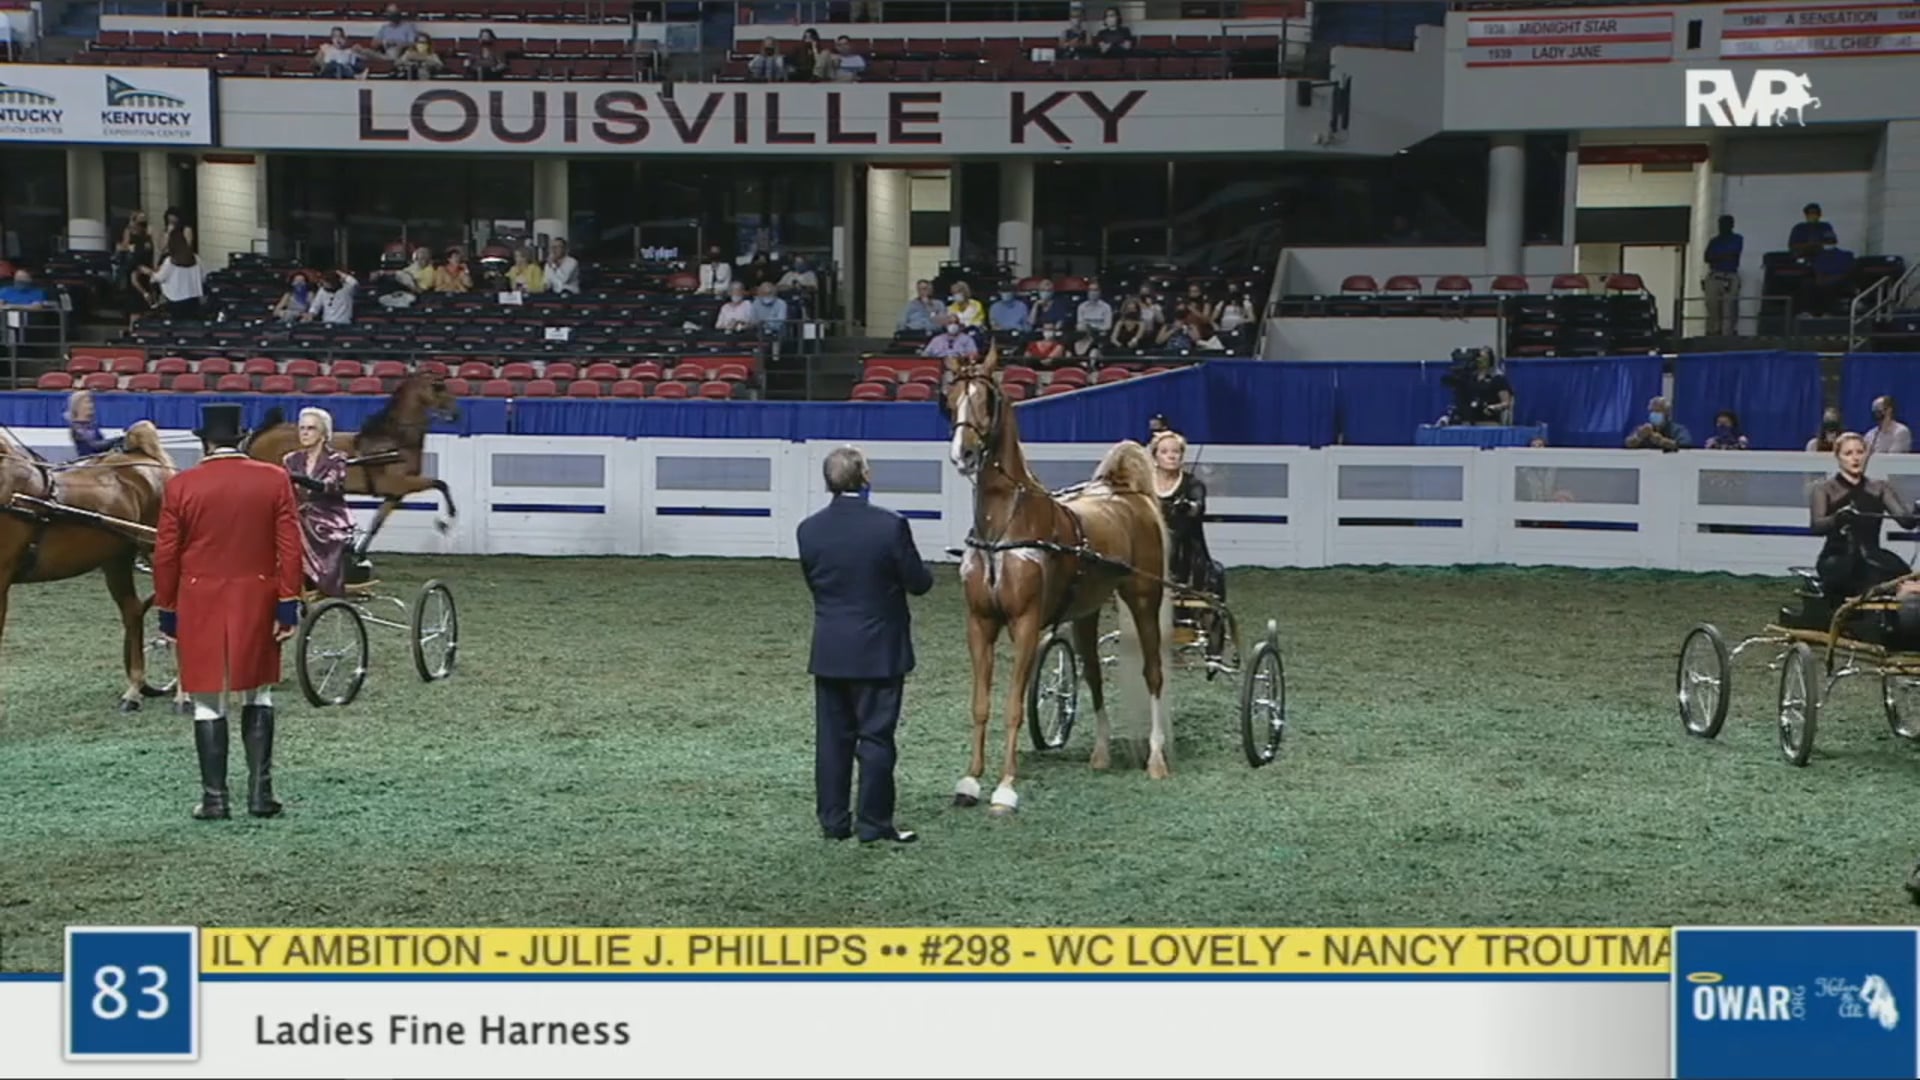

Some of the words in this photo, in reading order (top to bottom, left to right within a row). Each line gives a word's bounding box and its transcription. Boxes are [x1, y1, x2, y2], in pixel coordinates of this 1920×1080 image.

[1785, 14, 1795, 24] A
[1799, 11, 1878, 25] SENSATION
[1518, 21, 1581, 34] MIDNIGHT
[1584, 19, 1618, 33] STAR
[1841, 35, 1882, 49] CHIEF
[1532, 46, 1565, 59] LADY
[1568, 45, 1602, 58] JANE
[101, 112, 191, 126] KENTUCKY
[358, 89, 942, 144] LOUISVILLE
[1010, 90, 1148, 144] KY
[157, 129, 191, 138] CENTER
